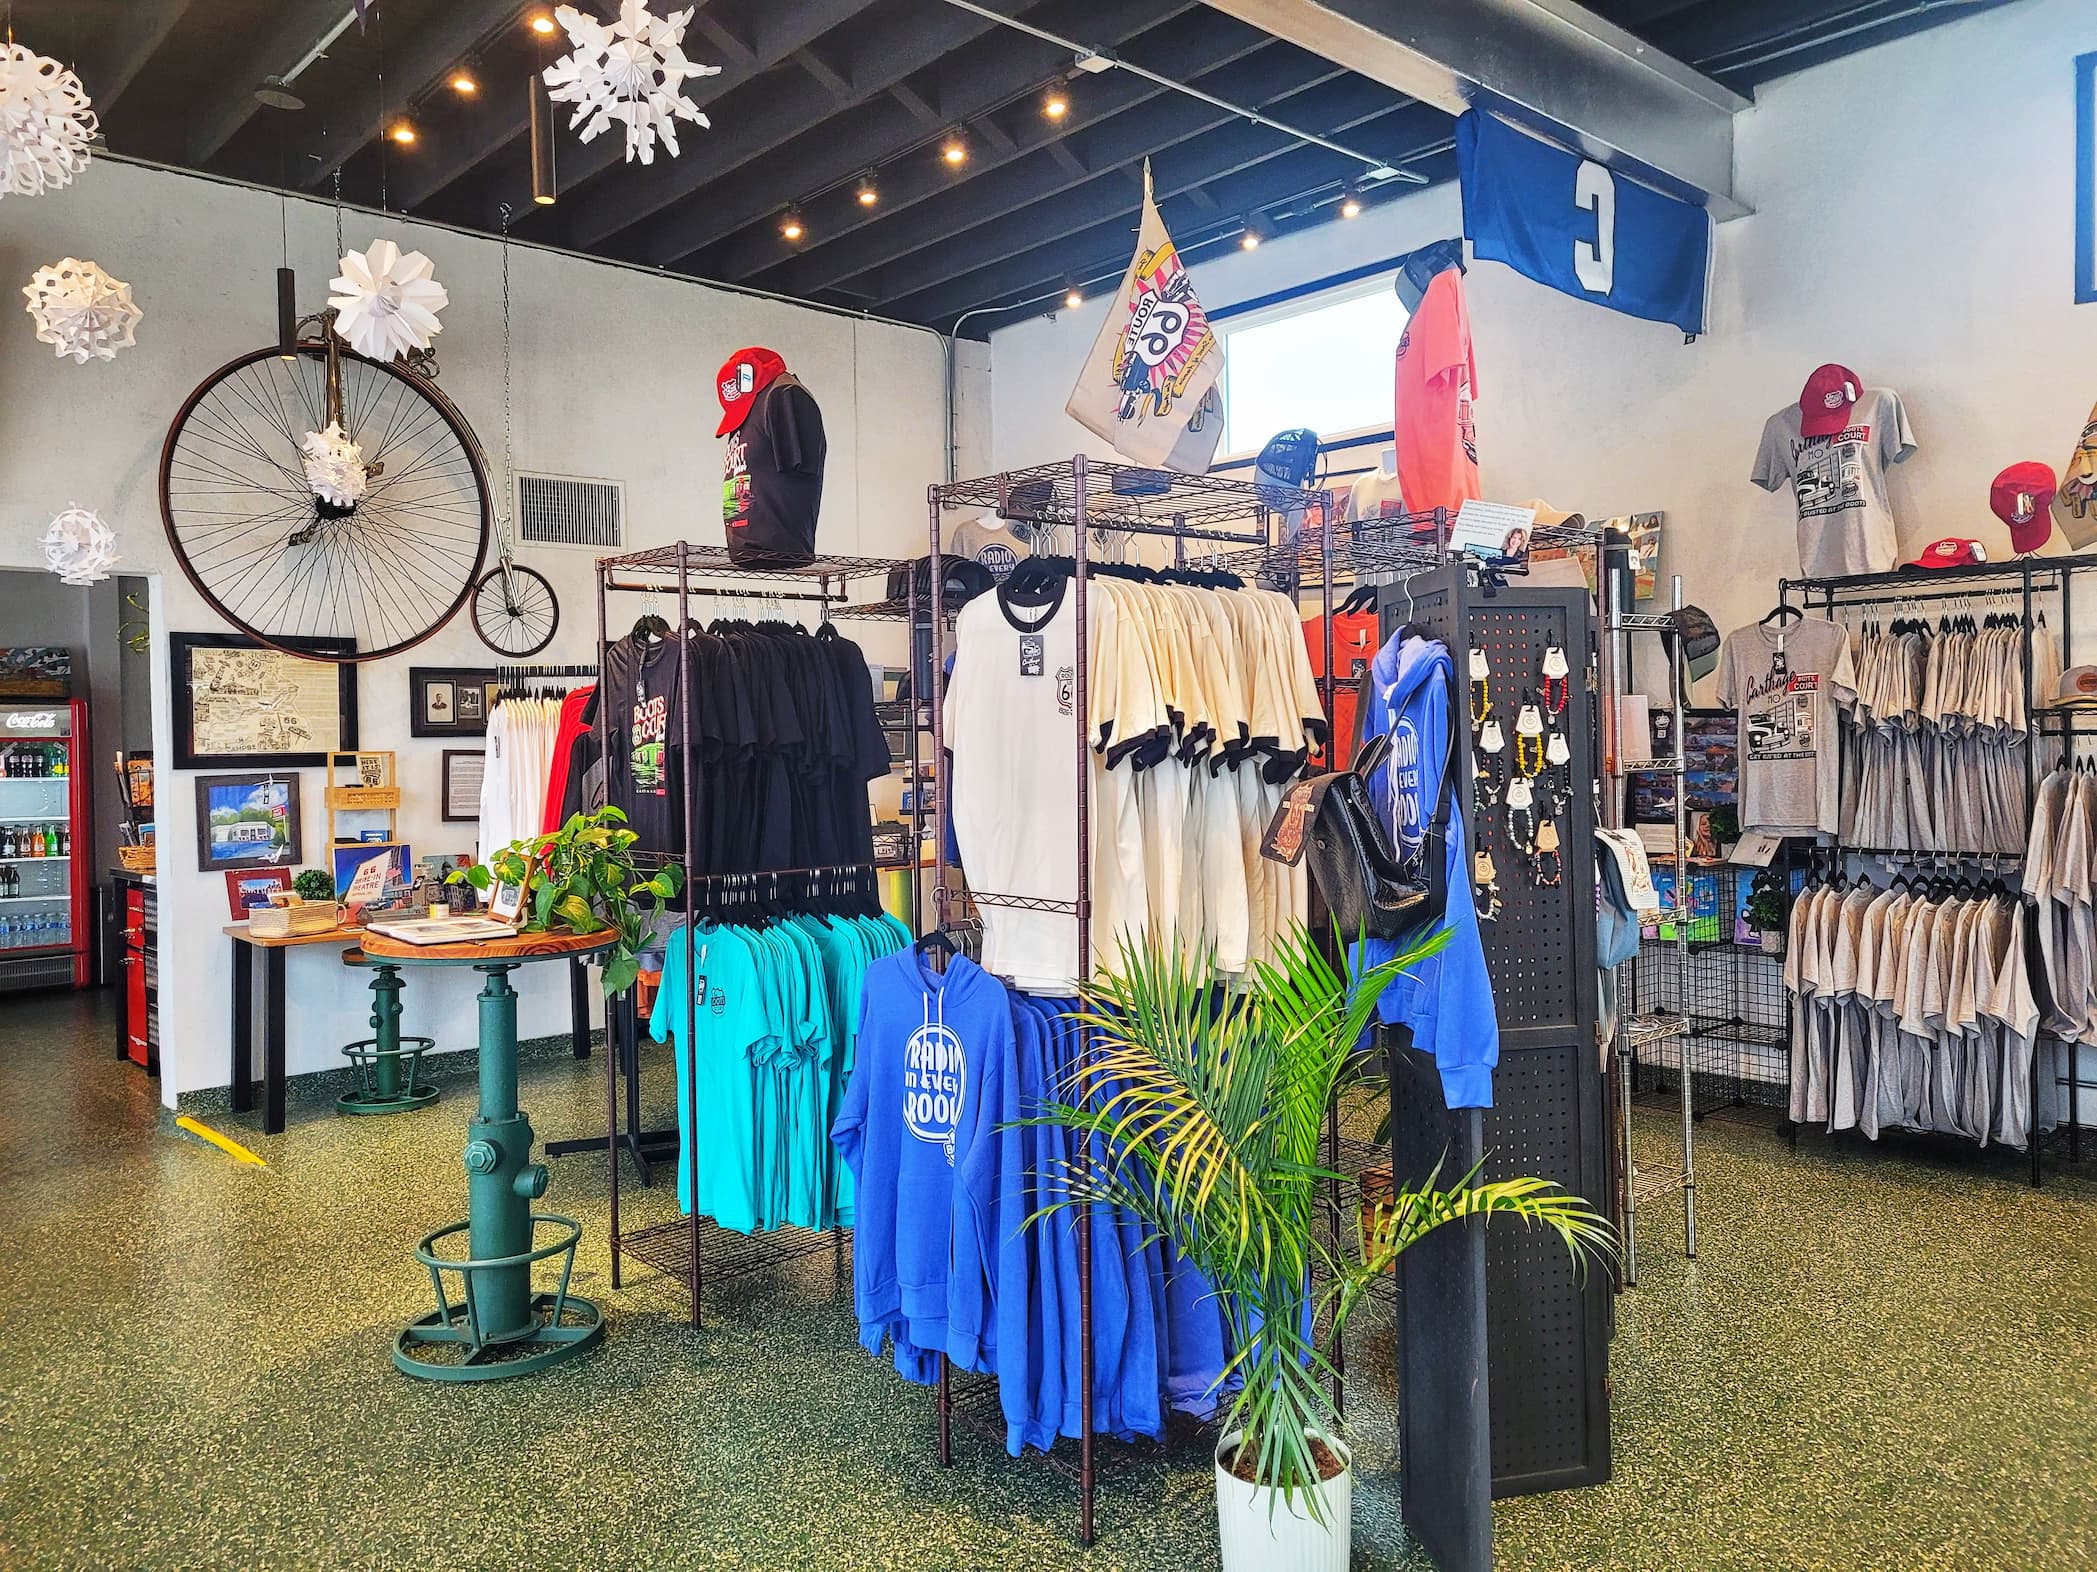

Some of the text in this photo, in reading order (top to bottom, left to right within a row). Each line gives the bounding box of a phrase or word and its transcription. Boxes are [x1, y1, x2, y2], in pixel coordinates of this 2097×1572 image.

[1837, 431, 1866, 442] COURT
[980, 550, 1012, 566] RADIO
[988, 563, 1015, 573] EVERY
[6, 712, 57, 729] Coca-Cola
[363, 865, 377, 876] 66
